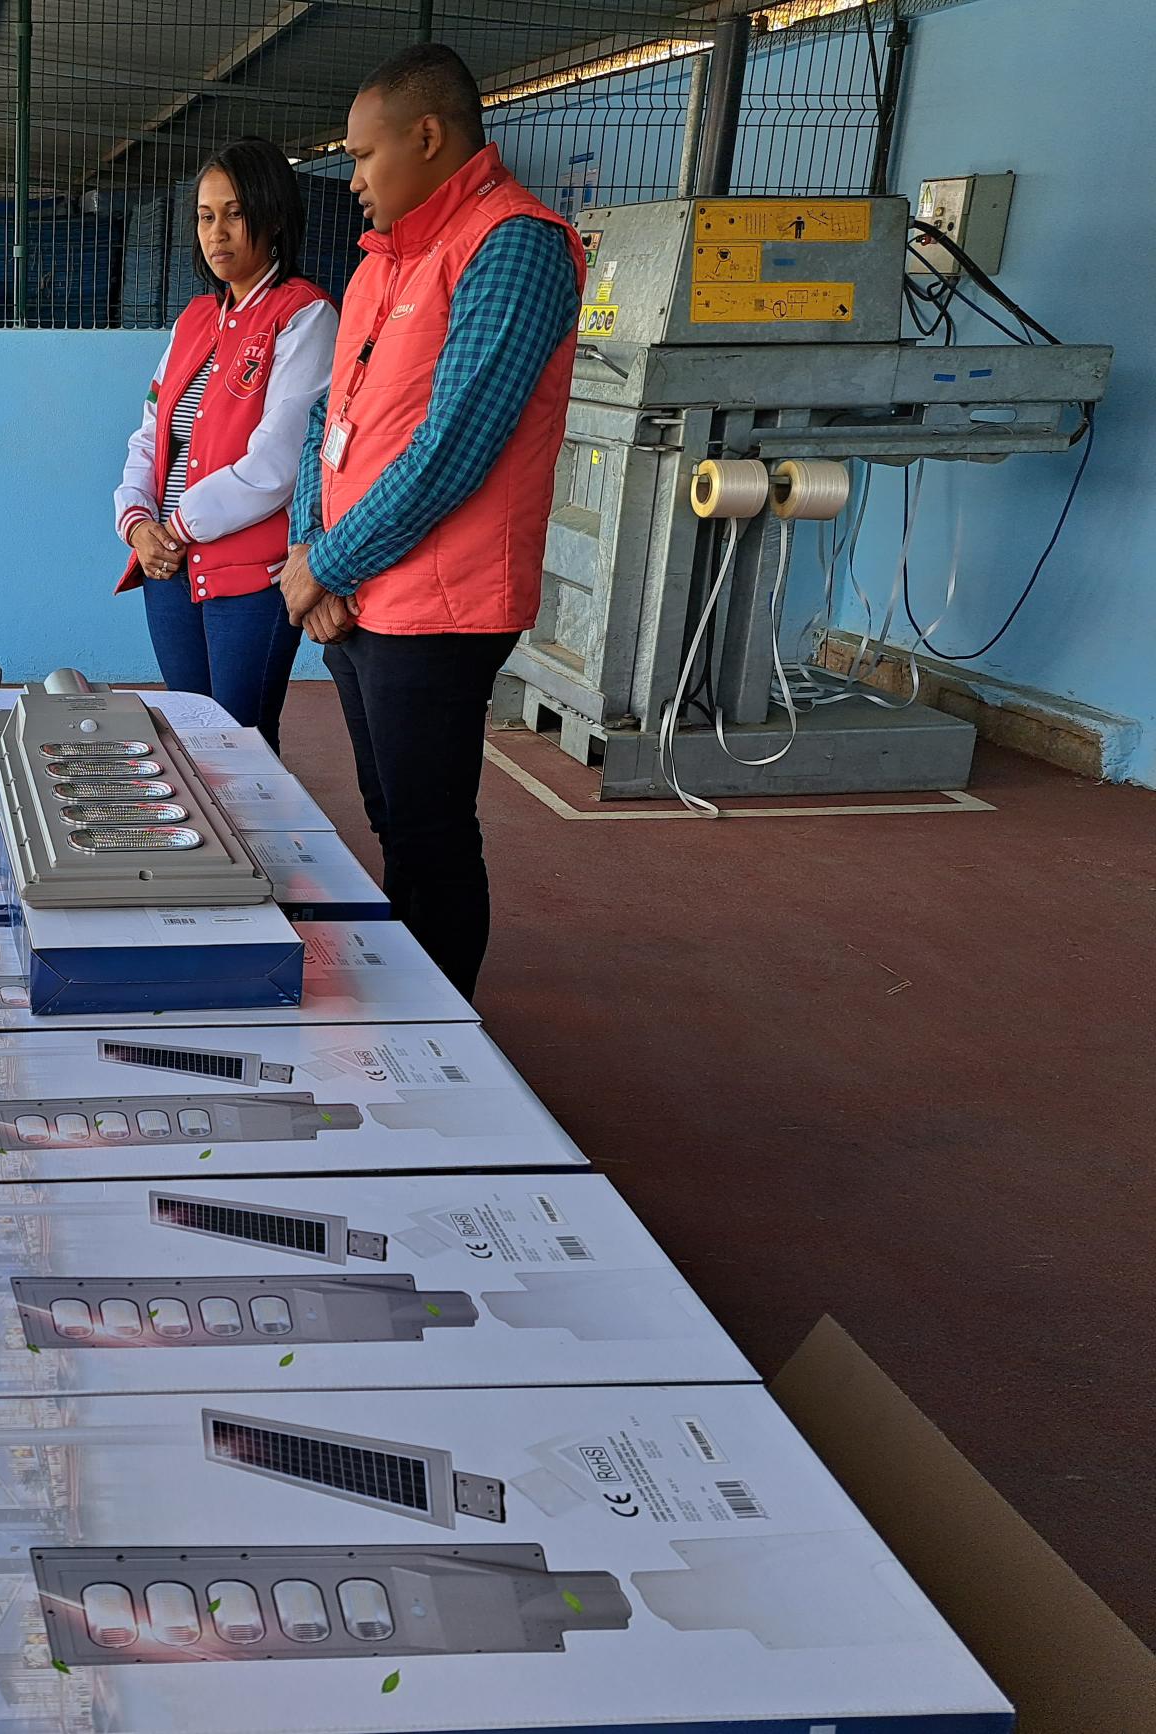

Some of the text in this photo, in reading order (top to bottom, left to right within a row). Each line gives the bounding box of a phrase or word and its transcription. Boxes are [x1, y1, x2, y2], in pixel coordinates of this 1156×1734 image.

[243, 345, 265, 360] STA
[241, 358, 261, 384] 7
[454, 1214, 477, 1236] RoHS
[465, 1242, 493, 1259] CE
[585, 1447, 615, 1480] RoHS
[603, 1491, 640, 1518] CE
